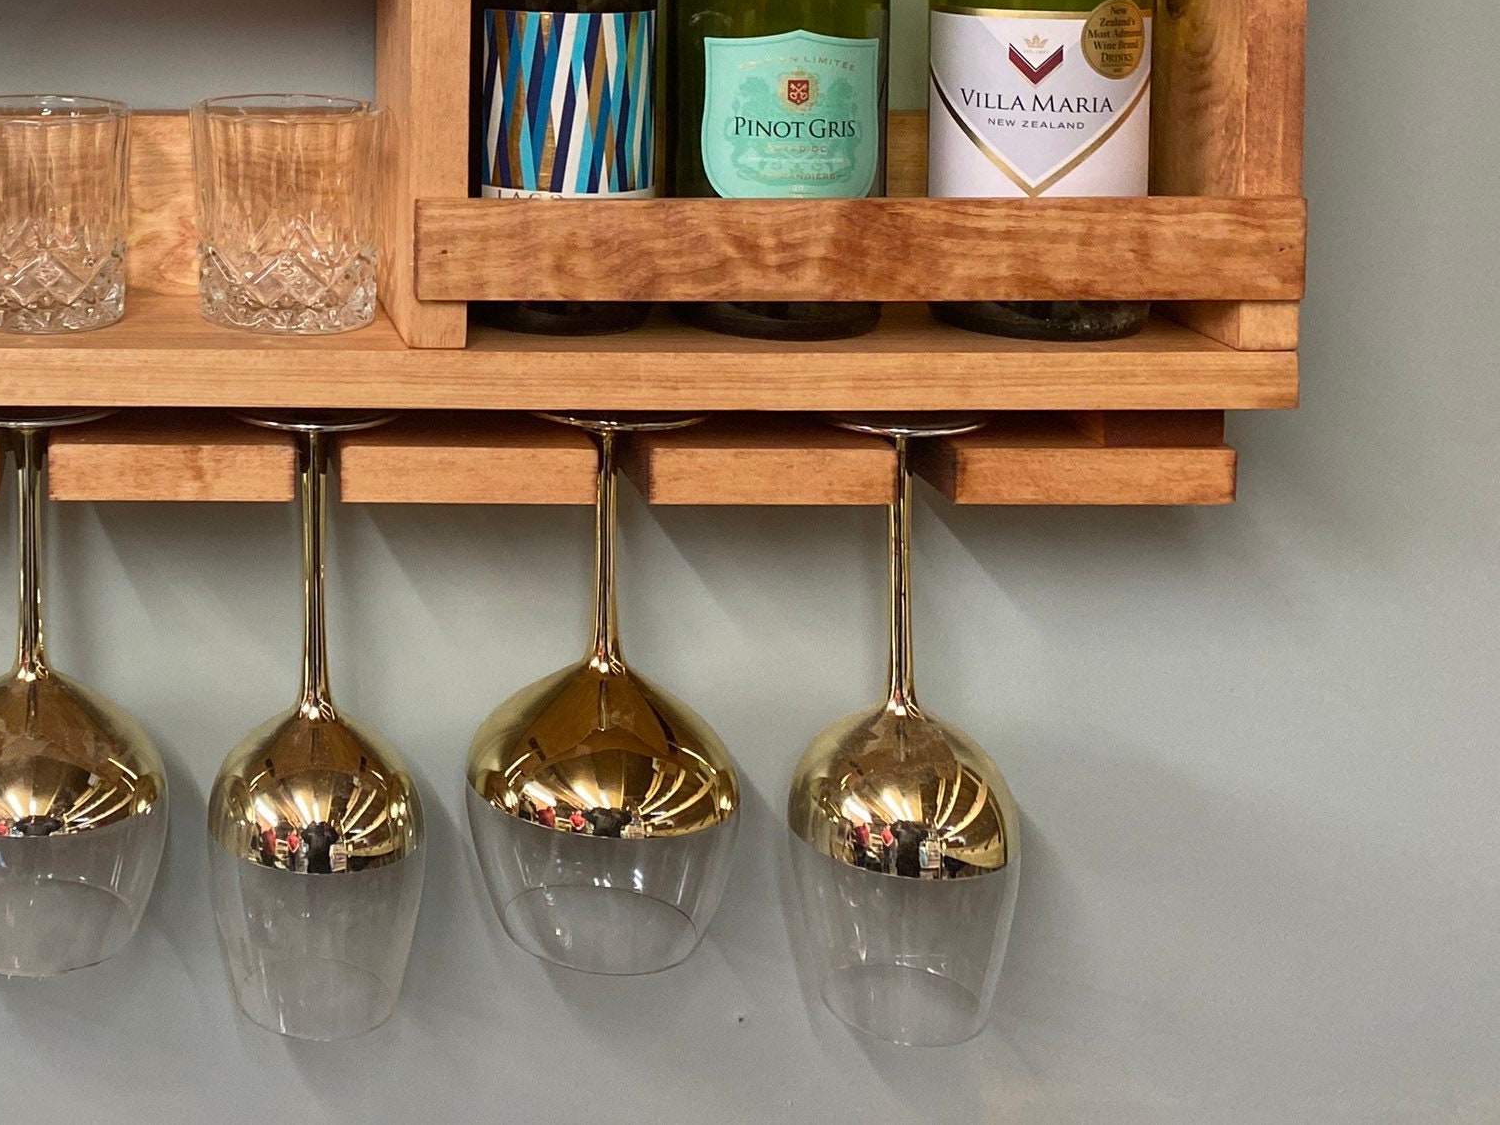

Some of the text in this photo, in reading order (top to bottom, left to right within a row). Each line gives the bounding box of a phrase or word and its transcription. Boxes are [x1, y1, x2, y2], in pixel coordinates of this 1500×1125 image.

[1093, 41, 1116, 50] Wine
[1101, 53, 1134, 63] DRINKS
[960, 87, 1116, 113] VILLA MARIA
[734, 116, 856, 139] PINOT GRIS
[988, 117, 1085, 131] NEW ZEALAND
